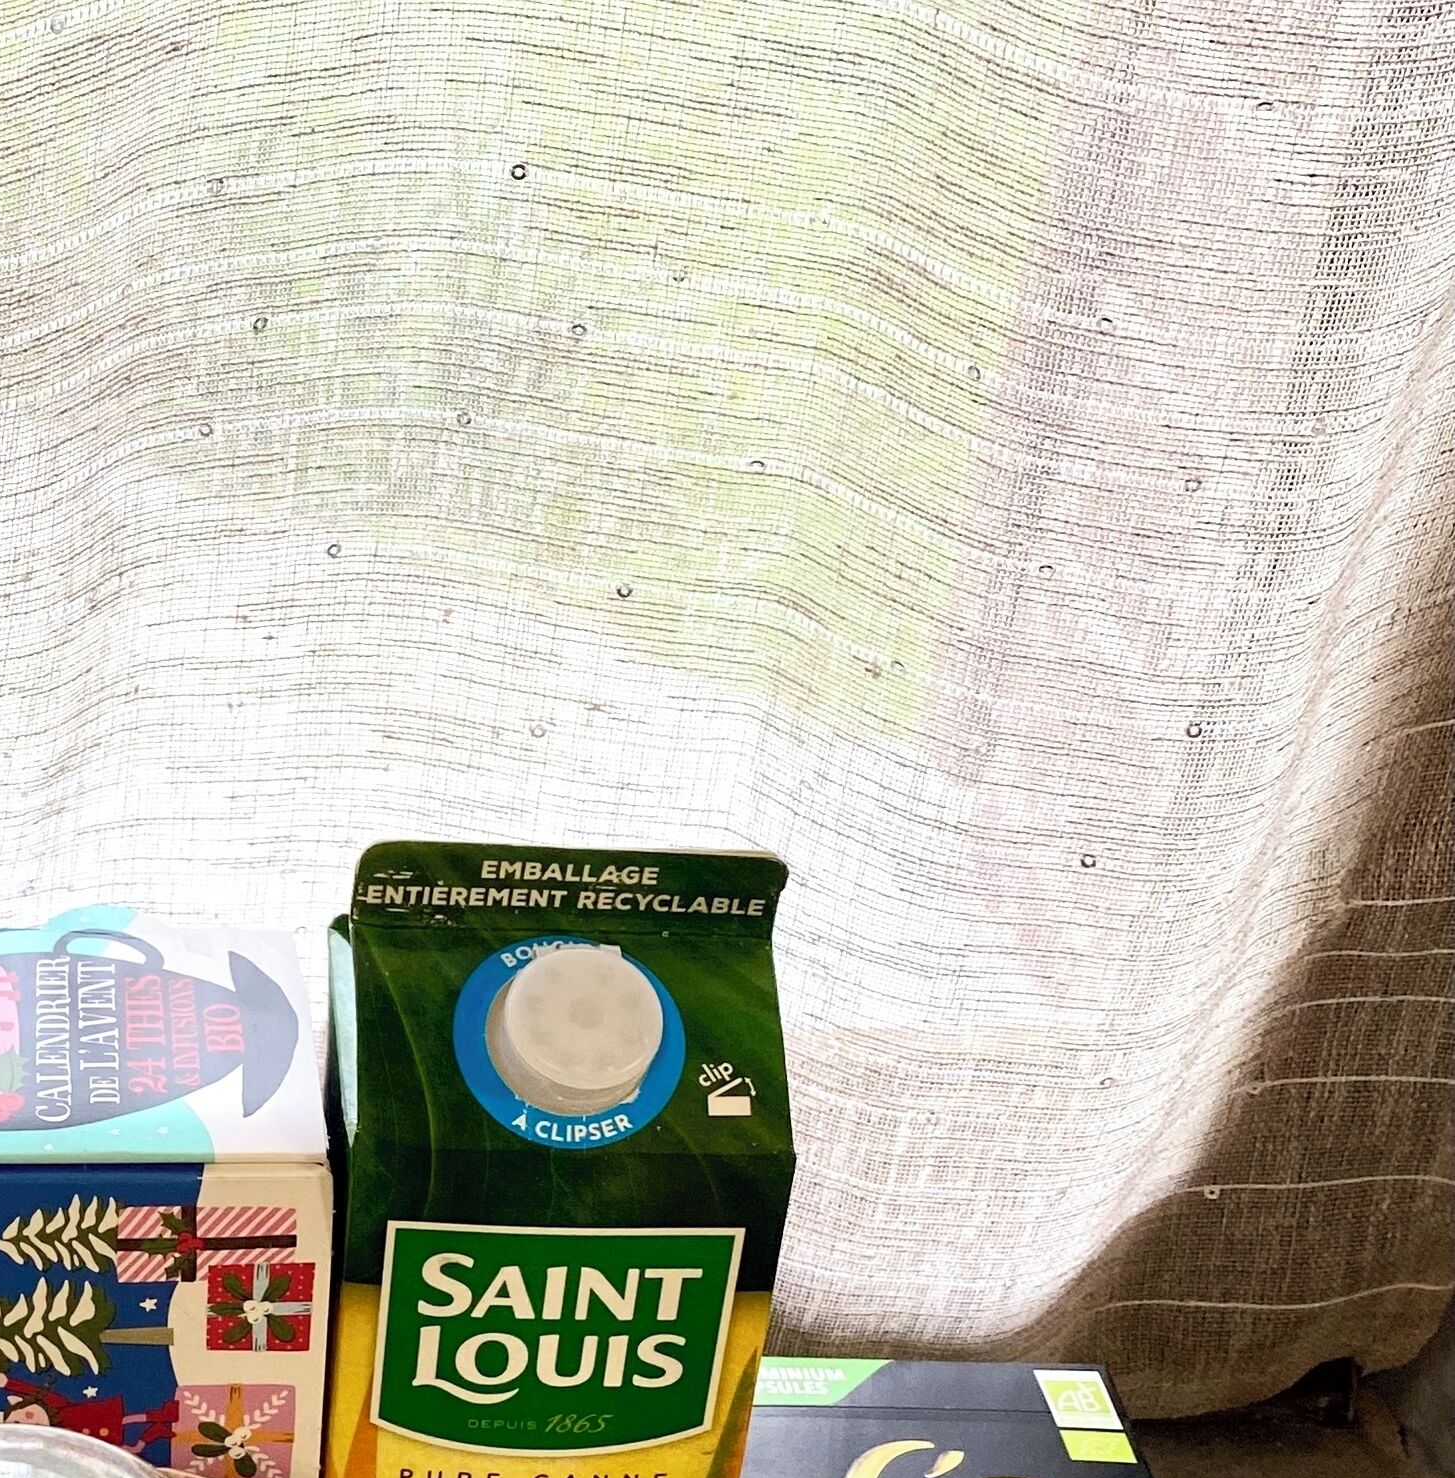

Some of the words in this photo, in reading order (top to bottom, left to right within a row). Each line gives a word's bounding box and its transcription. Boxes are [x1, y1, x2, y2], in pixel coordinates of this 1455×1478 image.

[481, 860, 660, 886] EMBALLAGE
[577, 891, 766, 917] RECYCLABLE
[77, 960, 120, 1071] L'AVENT
[203, 1003, 245, 1053] BIO
[35, 954, 72, 1123] CALENDRIER
[127, 1057, 168, 1094] 24
[698, 1061, 734, 1087] clip
[89, 1076, 121, 1105] DE
[534, 1113, 634, 1143] CLIPSER
[417, 1253, 703, 1321] SAINT
[412, 1325, 686, 1403] LOUIS
[761, 1367, 844, 1381] MINIUM
[467, 1418, 537, 1431] DEPUIS
[545, 1413, 614, 1433] 1865
